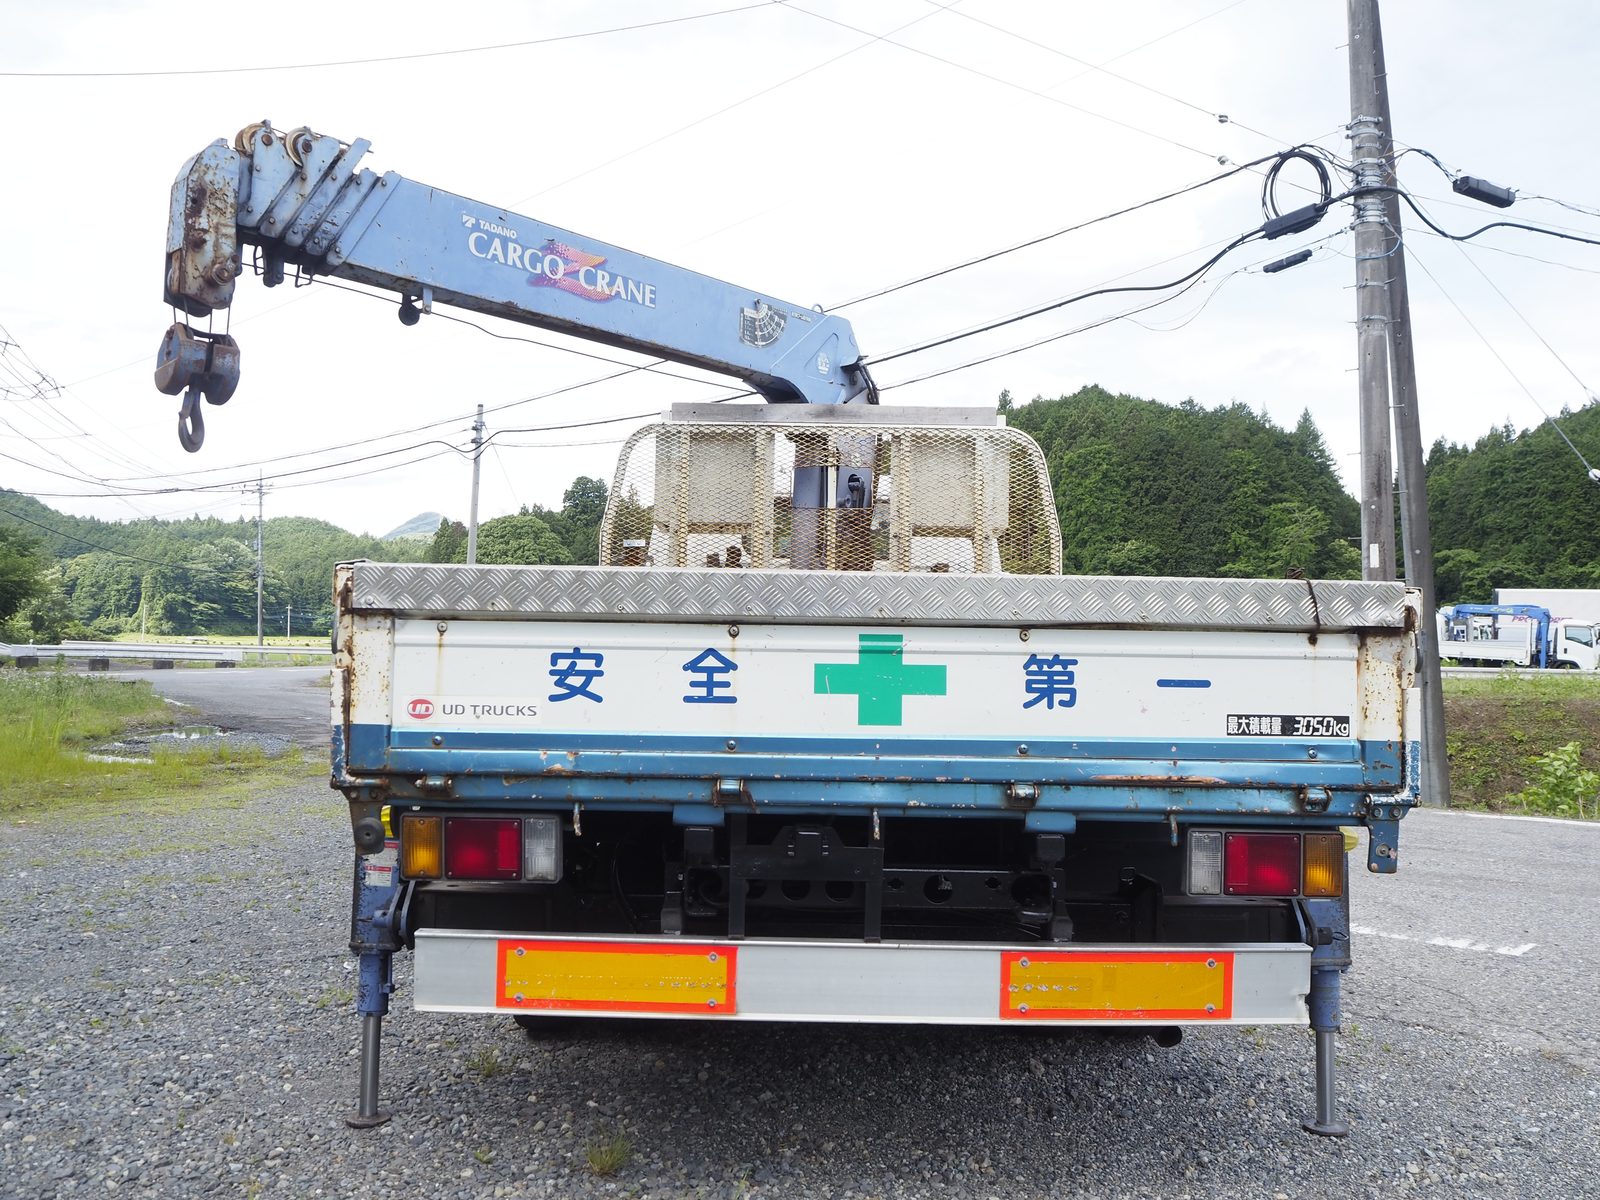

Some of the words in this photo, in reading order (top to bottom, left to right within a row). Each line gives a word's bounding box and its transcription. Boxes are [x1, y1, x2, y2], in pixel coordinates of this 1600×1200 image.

[478, 219, 517, 239] TADANO
[467, 231, 565, 280] CARGO
[578, 266, 657, 308] CRANE
[442, 704, 465, 715] UD
[469, 704, 537, 717] TRUCKS
[1227, 716, 1282, 735] 最大積載量
[1292, 716, 1349, 737] 3050kg
